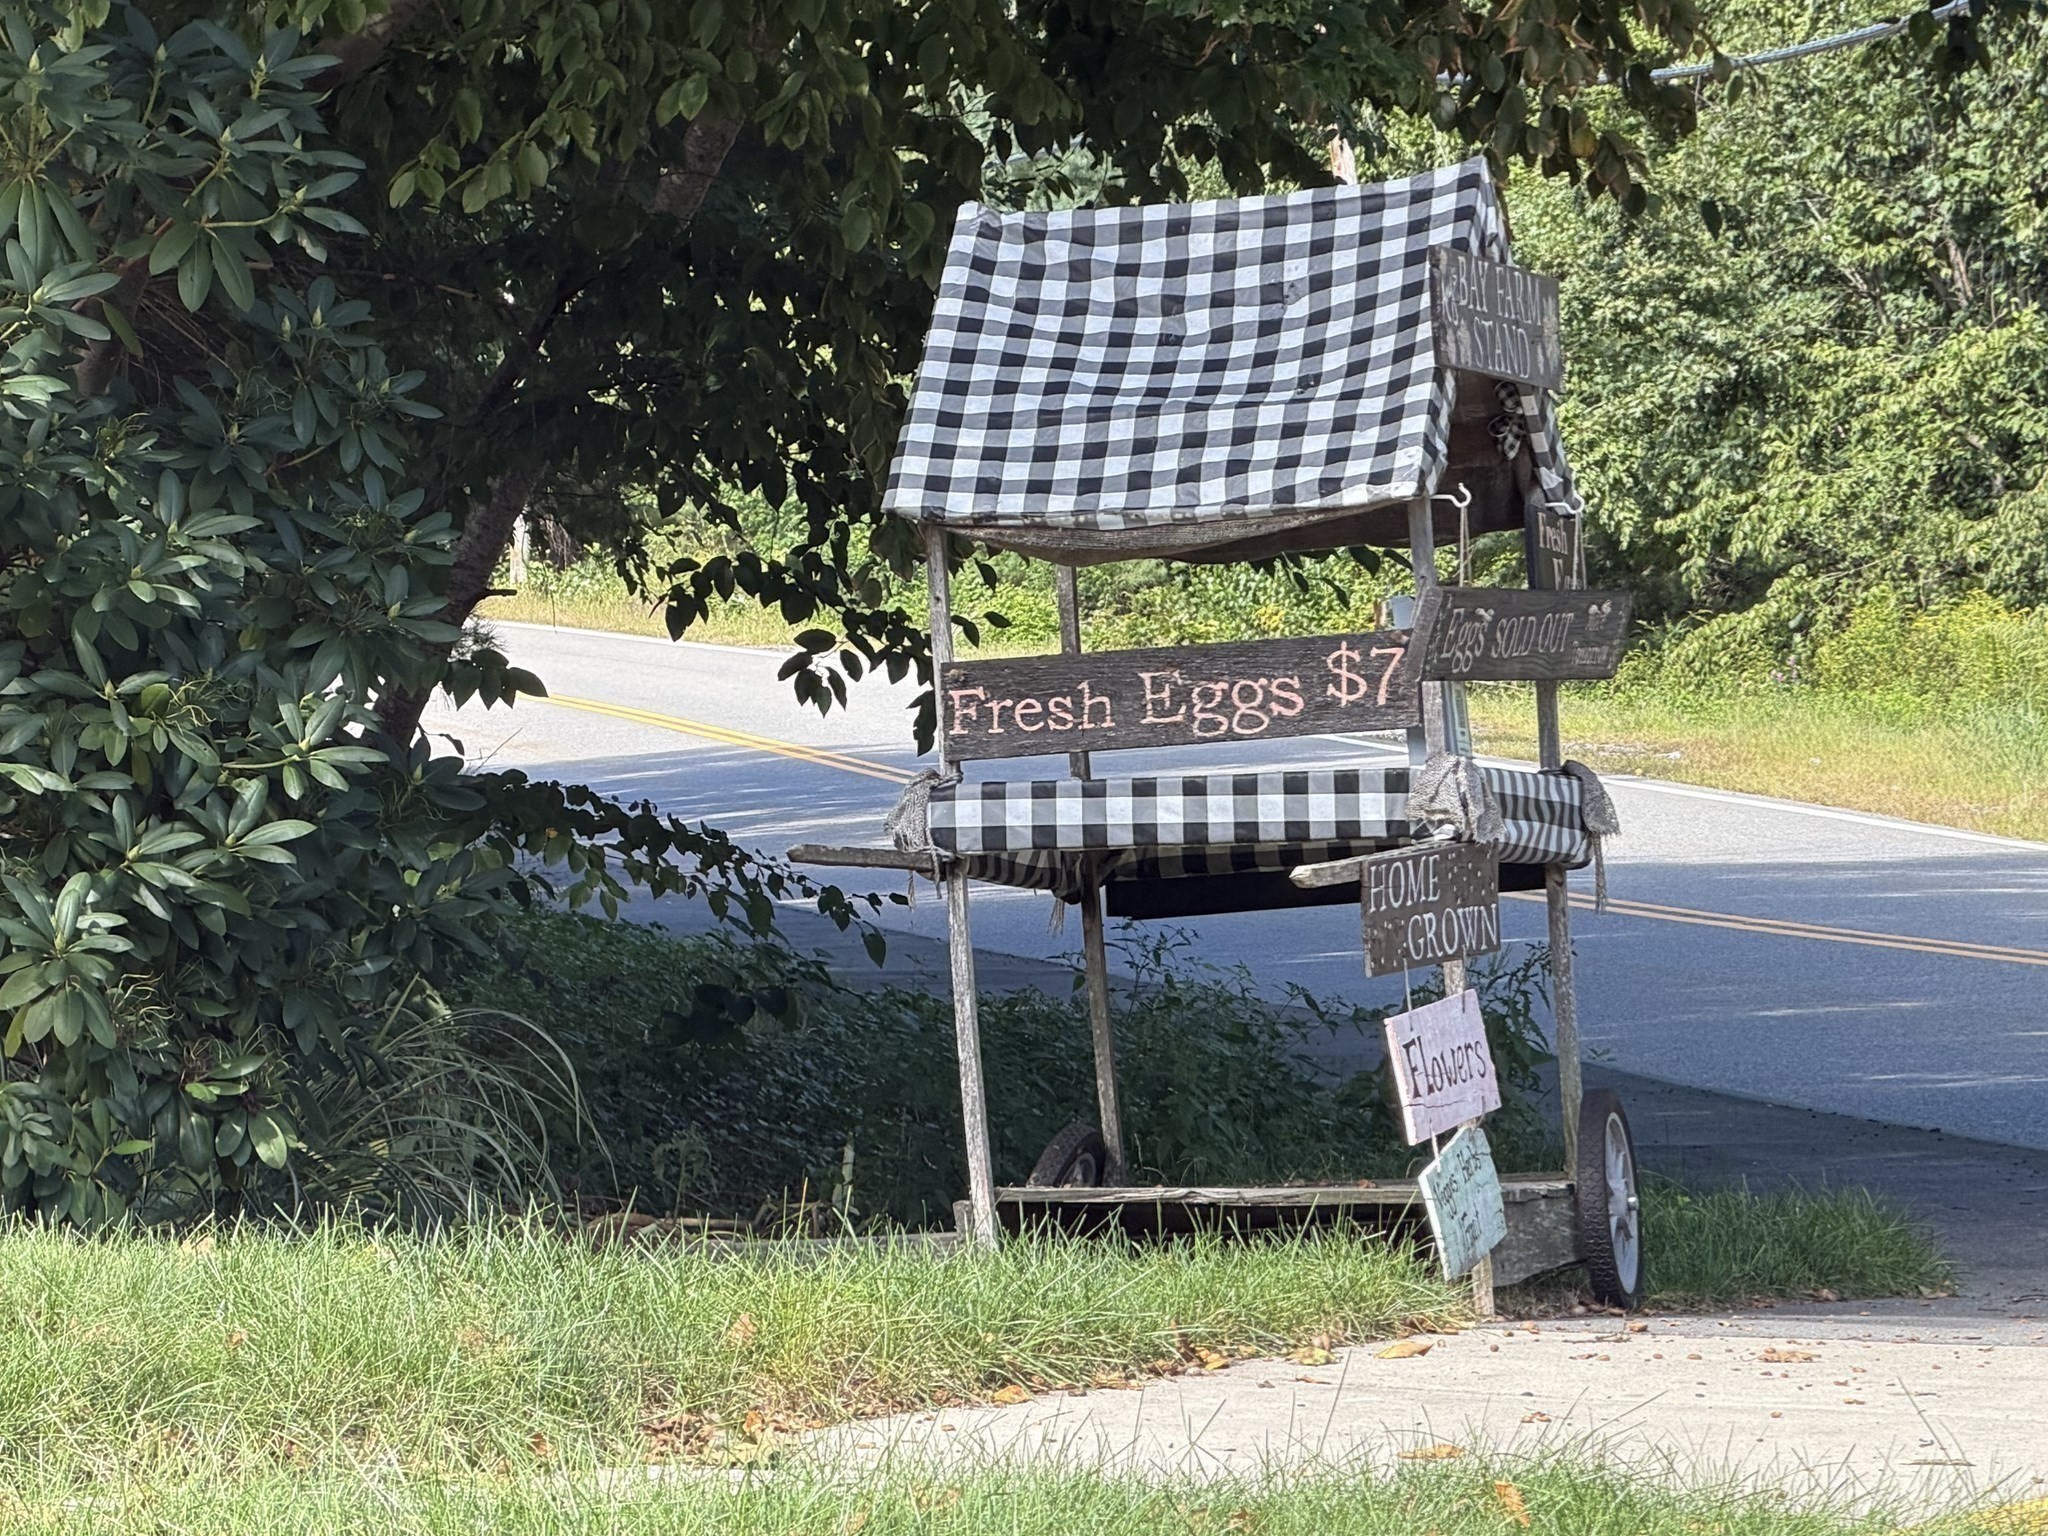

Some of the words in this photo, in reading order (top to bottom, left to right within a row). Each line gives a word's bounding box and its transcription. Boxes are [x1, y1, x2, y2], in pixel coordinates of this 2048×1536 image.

[1457, 256, 1489, 313] BAY
[1495, 266, 1541, 326] FARM
[1474, 316, 1530, 379] STAND
[1537, 512, 1569, 556] Fresh
[1441, 608, 1488, 674] Eggs
[1491, 613, 1536, 659] SOLD
[1538, 612, 1575, 653] OUT
[948, 680, 1112, 735] Fresh
[1139, 668, 1304, 738] Eggs
[1325, 641, 1405, 708] $7
[1369, 854, 1440, 914] HOME
[1408, 903, 1497, 961] GROWN
[1402, 1034, 1487, 1099] Flowers
